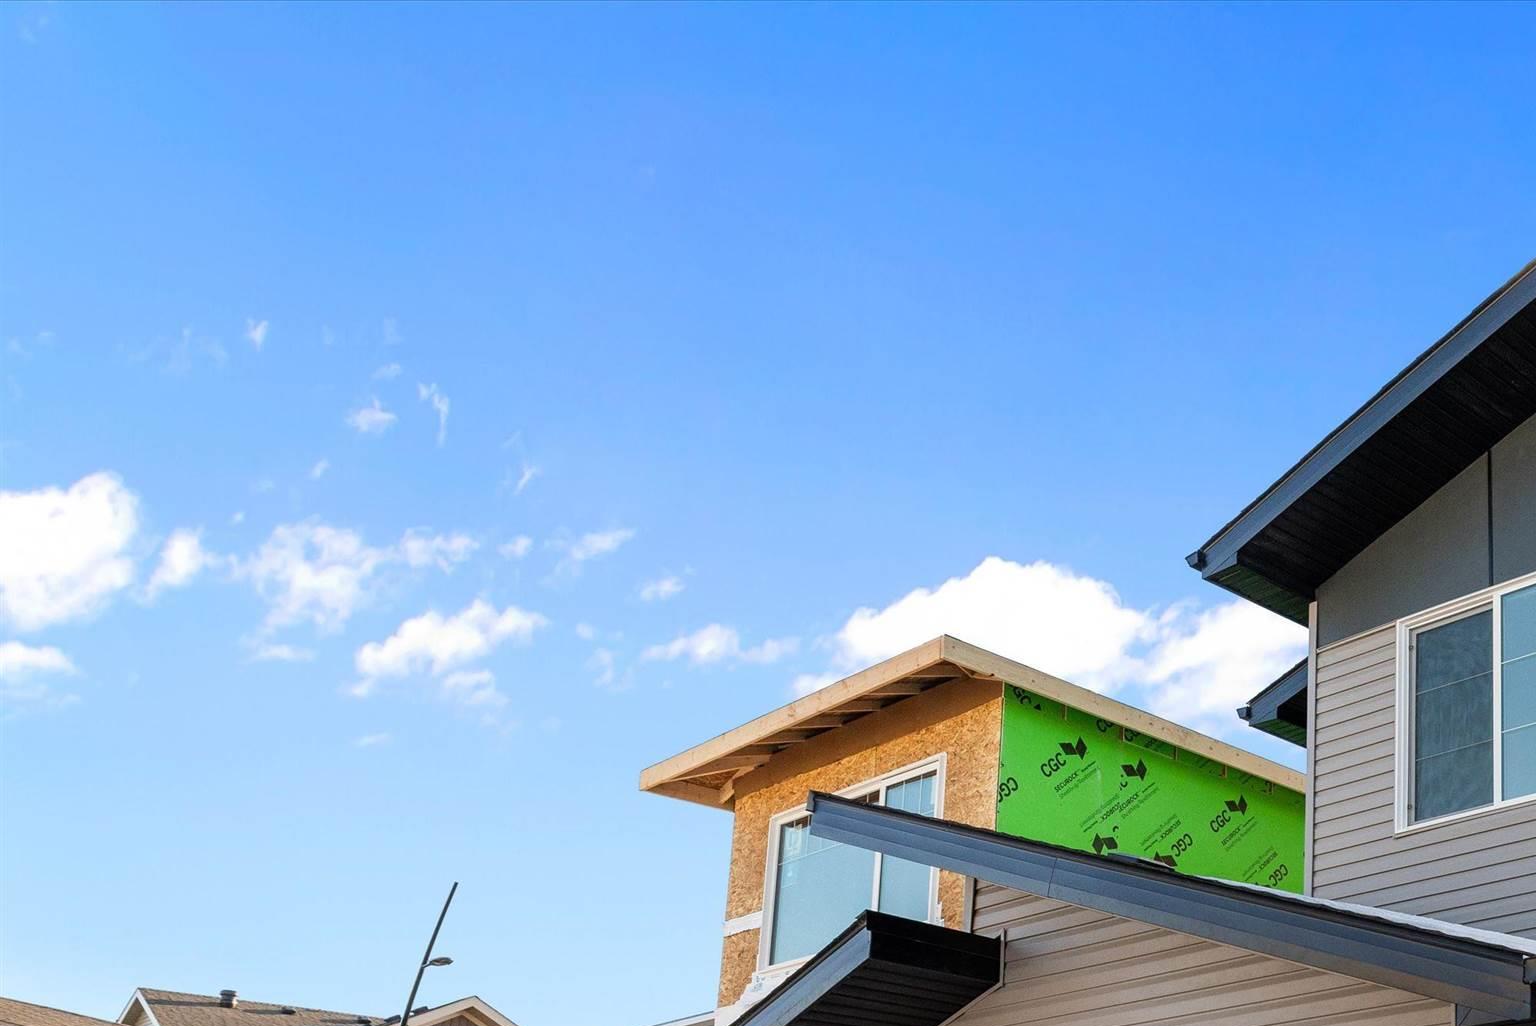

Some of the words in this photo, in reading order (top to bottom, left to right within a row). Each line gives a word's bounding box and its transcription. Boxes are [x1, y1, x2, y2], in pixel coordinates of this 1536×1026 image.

[1040, 752, 1067, 778] CGC
[1210, 809, 1232, 833] CGC
[1171, 833, 1193, 857] CGC
[1268, 864, 1288, 887] CGC
